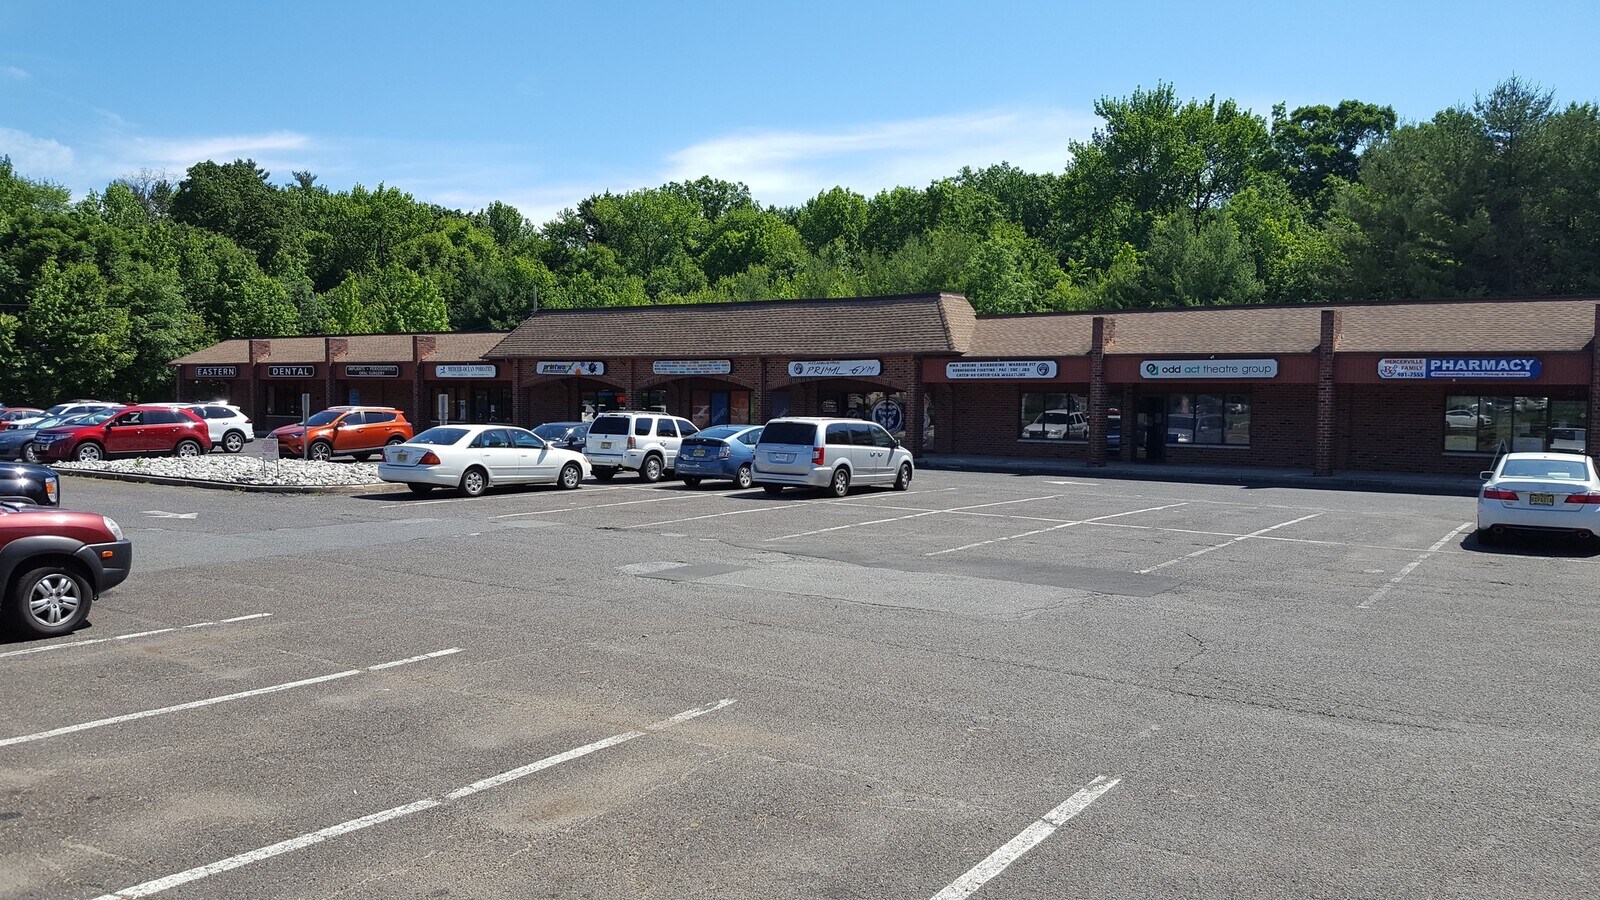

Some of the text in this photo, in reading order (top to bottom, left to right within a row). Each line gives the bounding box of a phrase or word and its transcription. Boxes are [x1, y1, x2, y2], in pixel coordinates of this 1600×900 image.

[806, 365, 875, 375] PRIMAL GYM
[1161, 364, 1272, 375] odd act theatre group
[1430, 359, 1535, 371] PHARMACY
[197, 368, 235, 376] EASTERN
